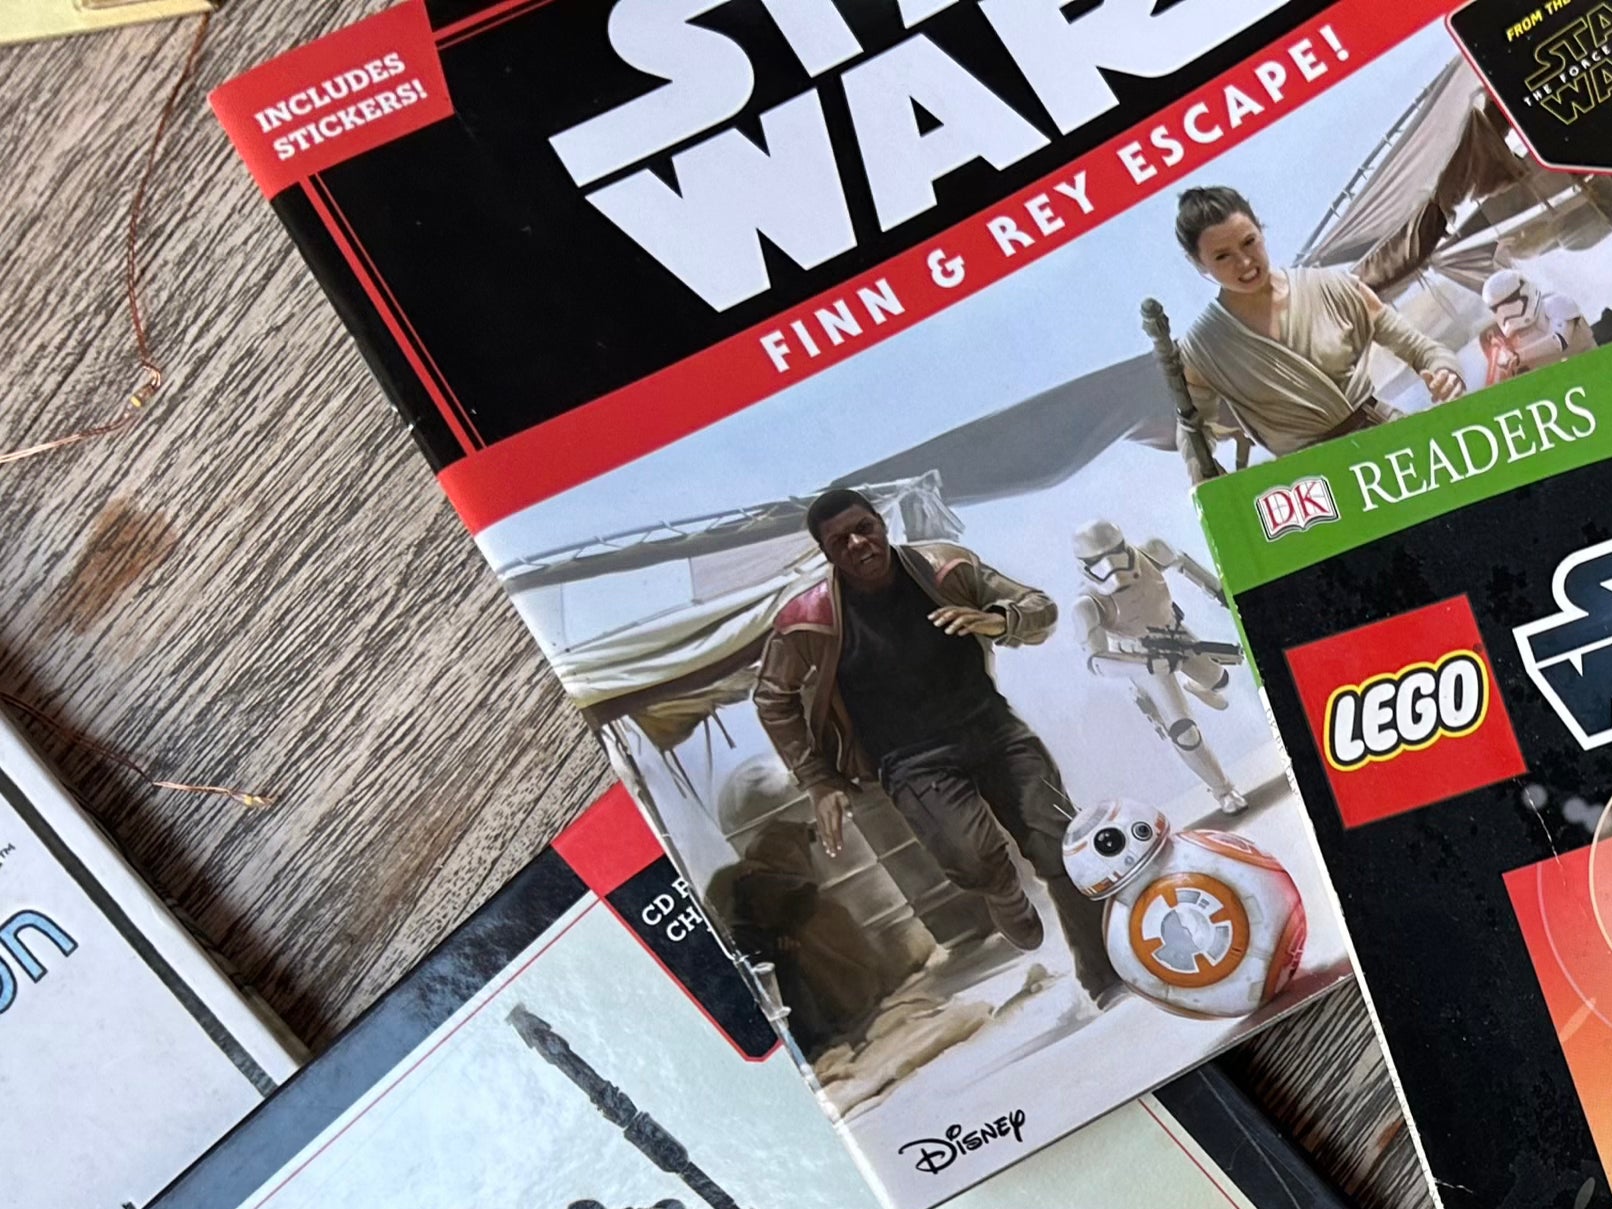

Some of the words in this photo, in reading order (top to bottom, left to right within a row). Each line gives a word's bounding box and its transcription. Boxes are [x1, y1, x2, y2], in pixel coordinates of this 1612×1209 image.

[1505, 9, 1543, 42] FROM
[254, 52, 406, 133] INCLUDES
[1523, 84, 1552, 107] THE
[1559, 46, 1611, 83] FORCE
[273, 78, 428, 161] STICKERS!
[759, 276, 906, 373] FINN
[927, 248, 966, 288] &
[986, 171, 1095, 257] REY
[1116, 24, 1350, 185] ESCAPE!
[1262, 480, 1328, 531] DK
[1350, 387, 1596, 512] READERS
[1329, 655, 1485, 767] LEGO
[641, 893, 675, 926] CD
